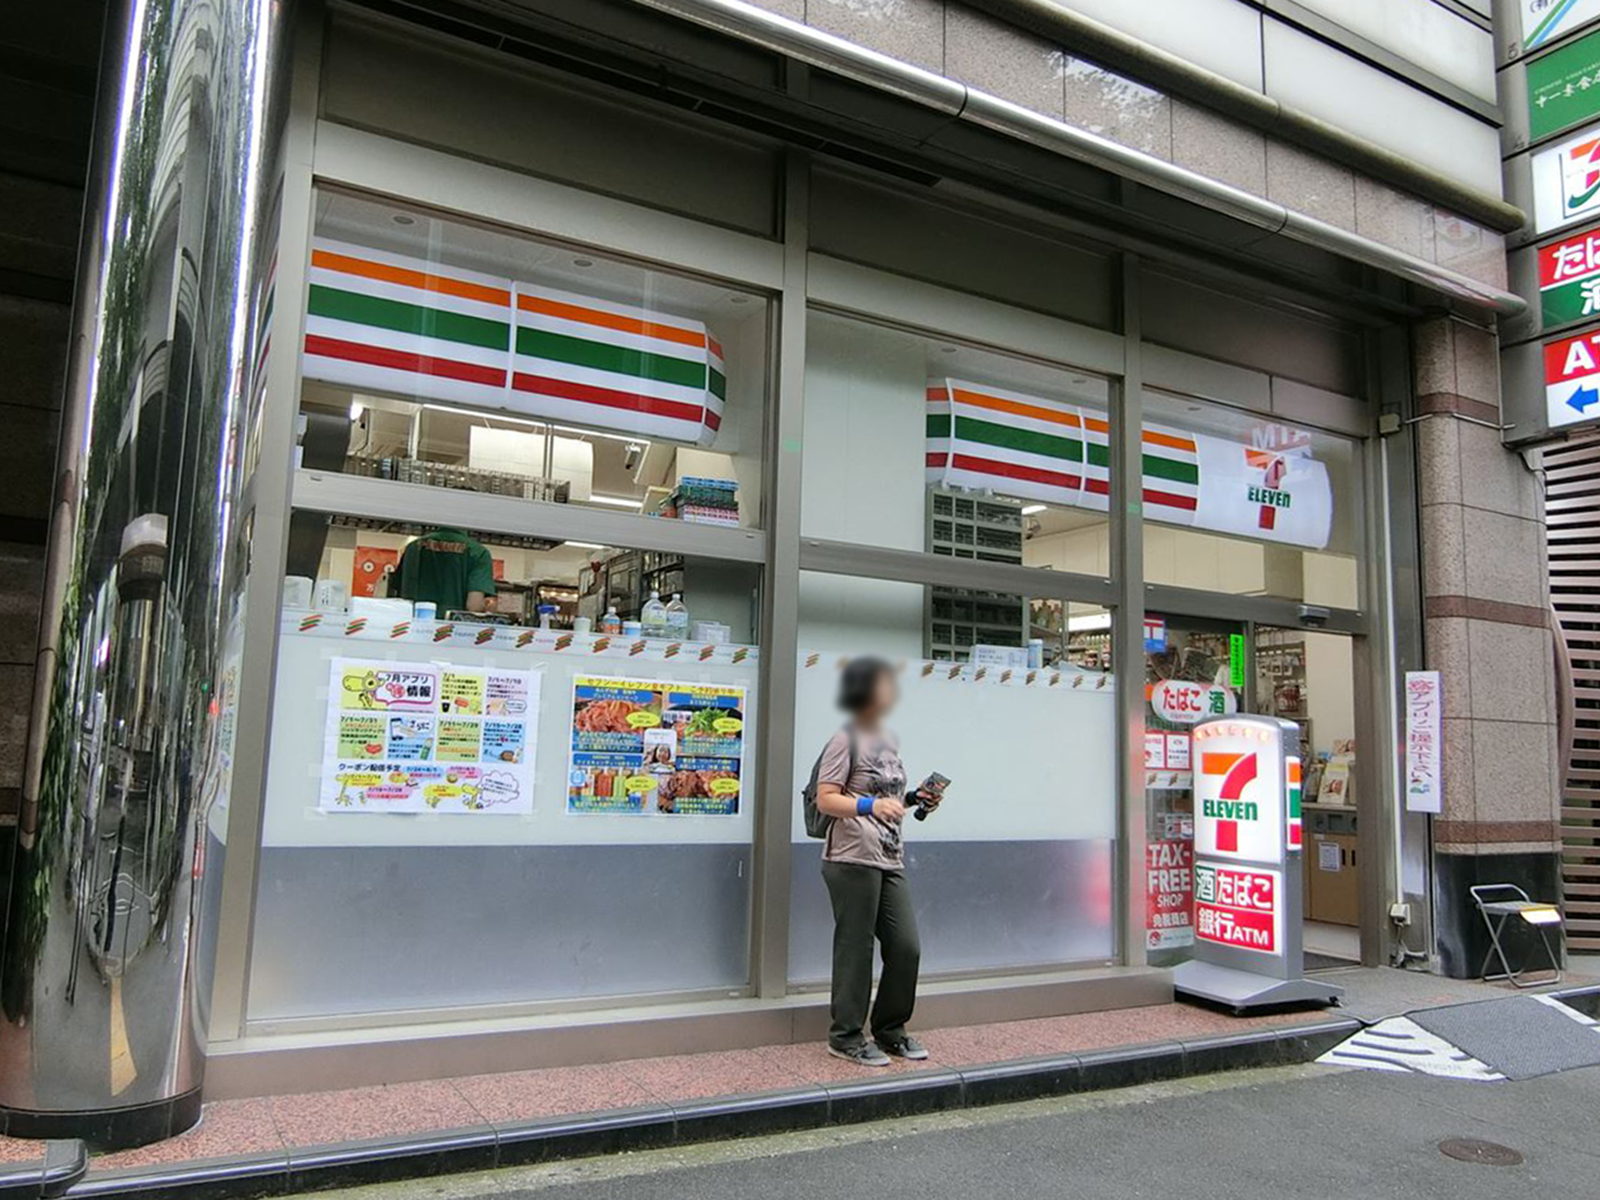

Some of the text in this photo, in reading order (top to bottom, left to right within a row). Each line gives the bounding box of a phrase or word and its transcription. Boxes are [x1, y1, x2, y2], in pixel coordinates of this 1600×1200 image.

[1163, 686, 1225, 714] たばこ 酒
[1148, 843, 1190, 868] TAX-
[1148, 868, 1191, 893] FREE
[1197, 867, 1272, 909] 酒 たばこ
[1157, 894, 1184, 908] SHOP
